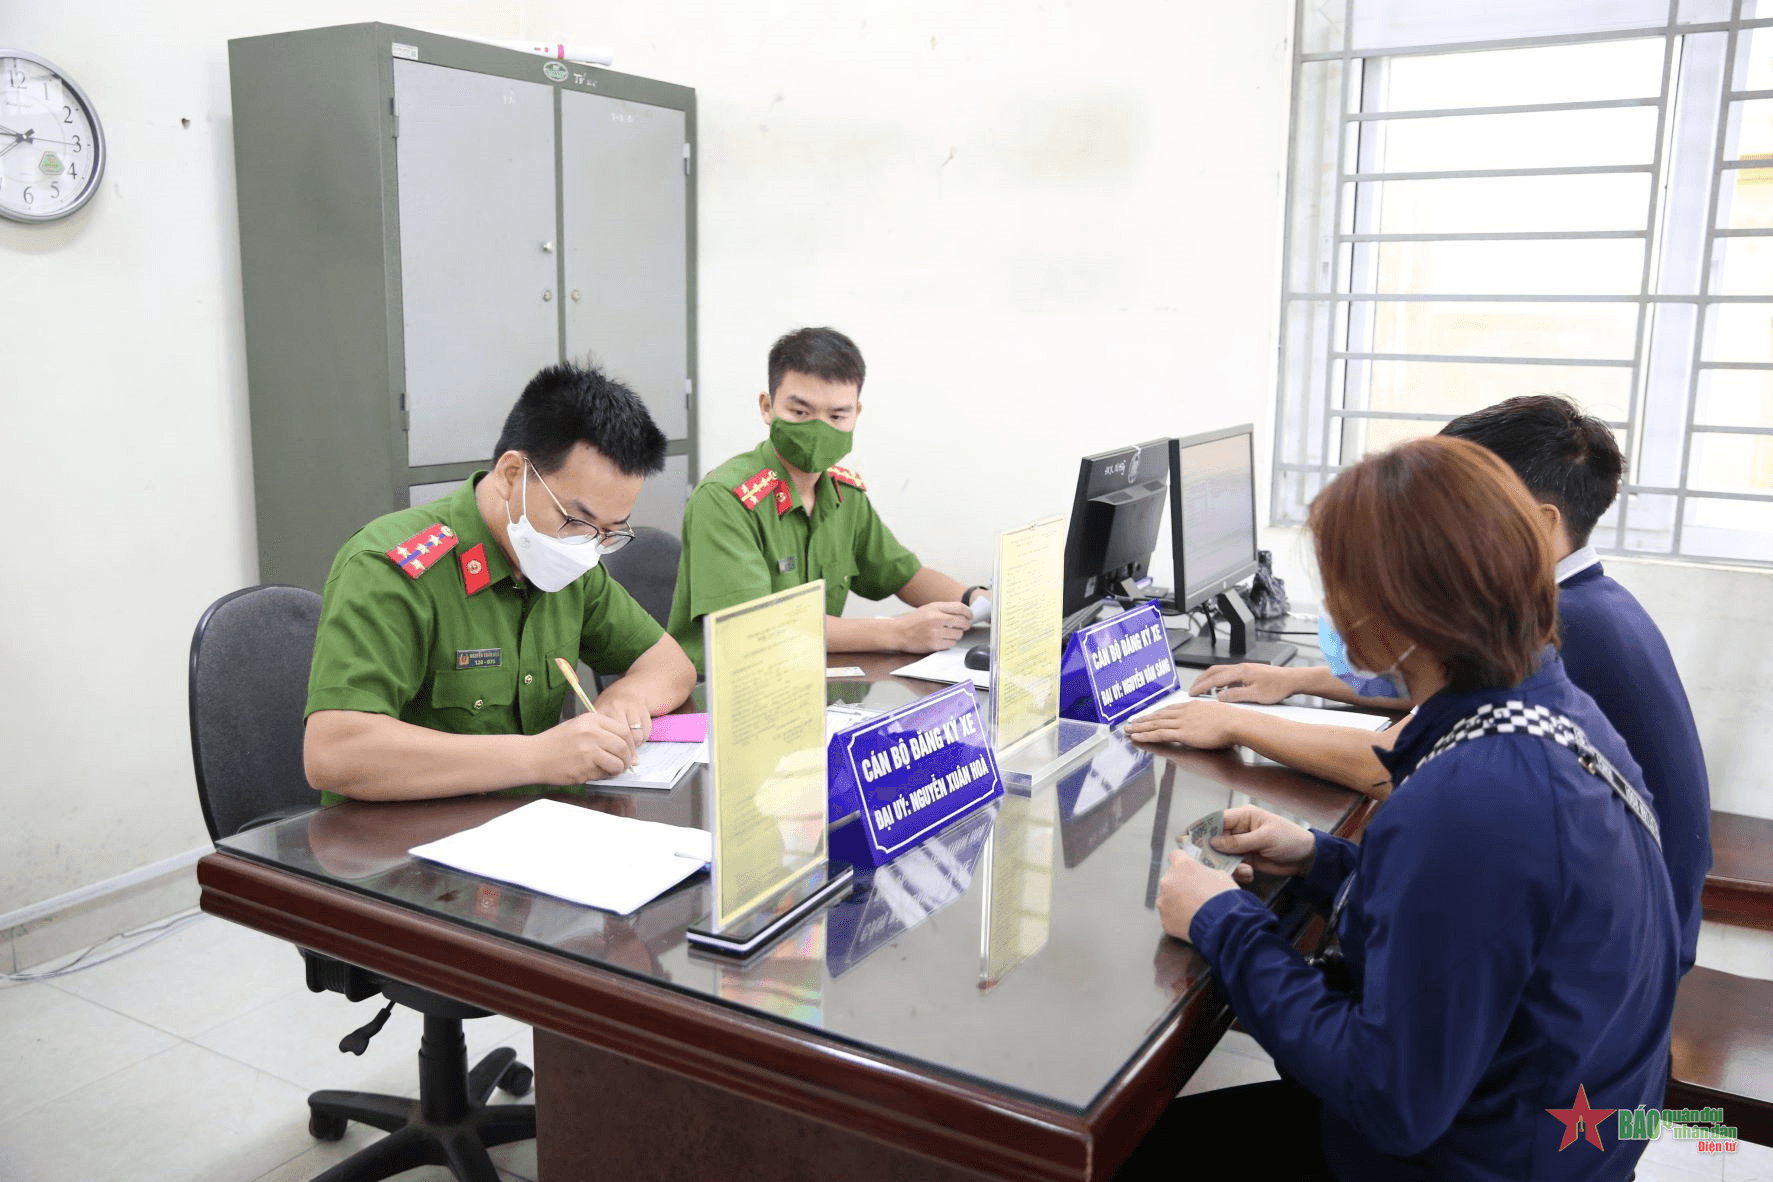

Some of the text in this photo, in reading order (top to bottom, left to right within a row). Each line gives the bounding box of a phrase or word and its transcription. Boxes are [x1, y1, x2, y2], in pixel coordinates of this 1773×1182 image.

[9, 69, 28, 90] 12
[42, 82, 50, 101] 1
[62, 105, 73, 124] 2
[72, 134, 82, 153] 3
[67, 162, 78, 180] 4
[23, 186, 34, 205] 6
[50, 181, 60, 199] 5
[1092, 624, 1162, 670] CÁN BỘ ĐĂNG KÝ XE
[1101, 688, 1113, 707] ĐẠI
[1122, 667, 1146, 696] NGUYỄN
[861, 712, 977, 783] CÁN BỘ ĐĂNG KÝ XE
[874, 753, 989, 831] ĐẠI UÝ: NGUYỄN XUÂN HOÀ
